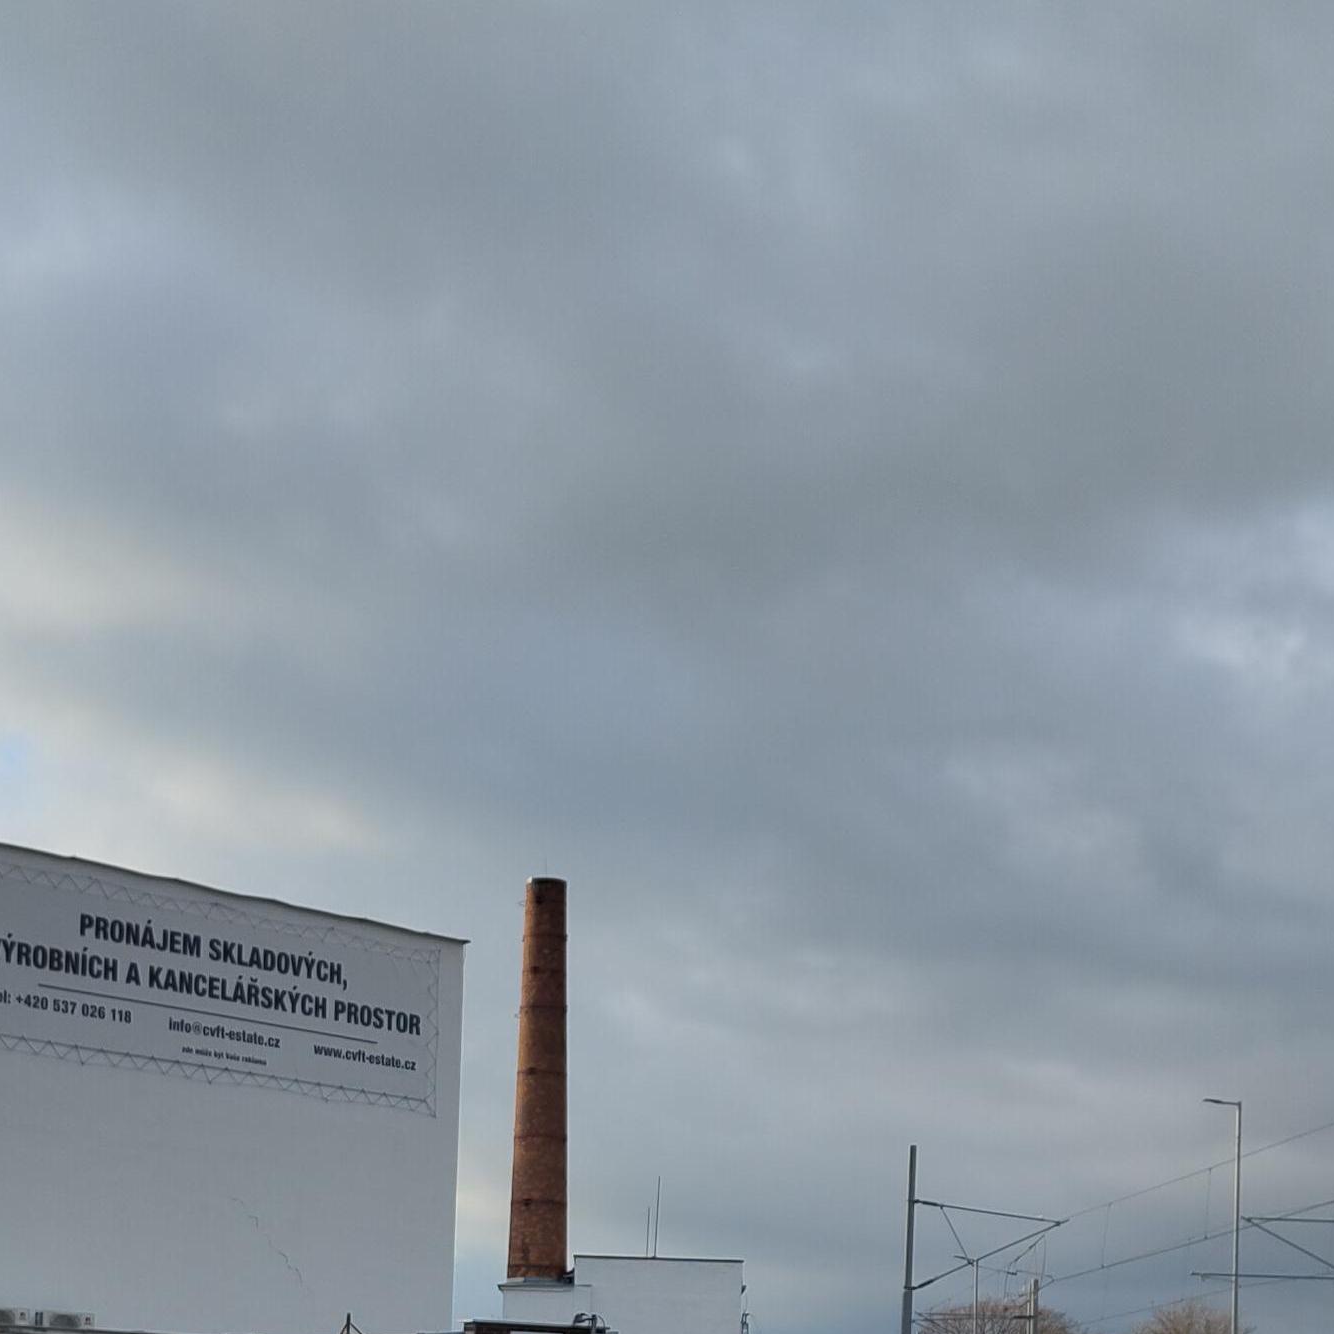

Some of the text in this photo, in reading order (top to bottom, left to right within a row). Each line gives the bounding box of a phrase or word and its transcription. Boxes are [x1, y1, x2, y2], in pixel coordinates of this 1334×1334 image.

[80, 913, 348, 991] PRONÁJEM SKLADOVÝCH,
[15, 993, 48, 1010] +420
[53, 998, 77, 1015] 537
[81, 1003, 106, 1019] 026
[110, 1008, 132, 1024] 118
[125, 961, 141, 986] A
[148, 965, 327, 1019] KANCELÁŘSKÝCH
[334, 999, 421, 1036] PROSTOR
[168, 1017, 281, 1049] info@cvft-estate.cz
[313, 1043, 417, 1071] www.cvft-estate.cz
